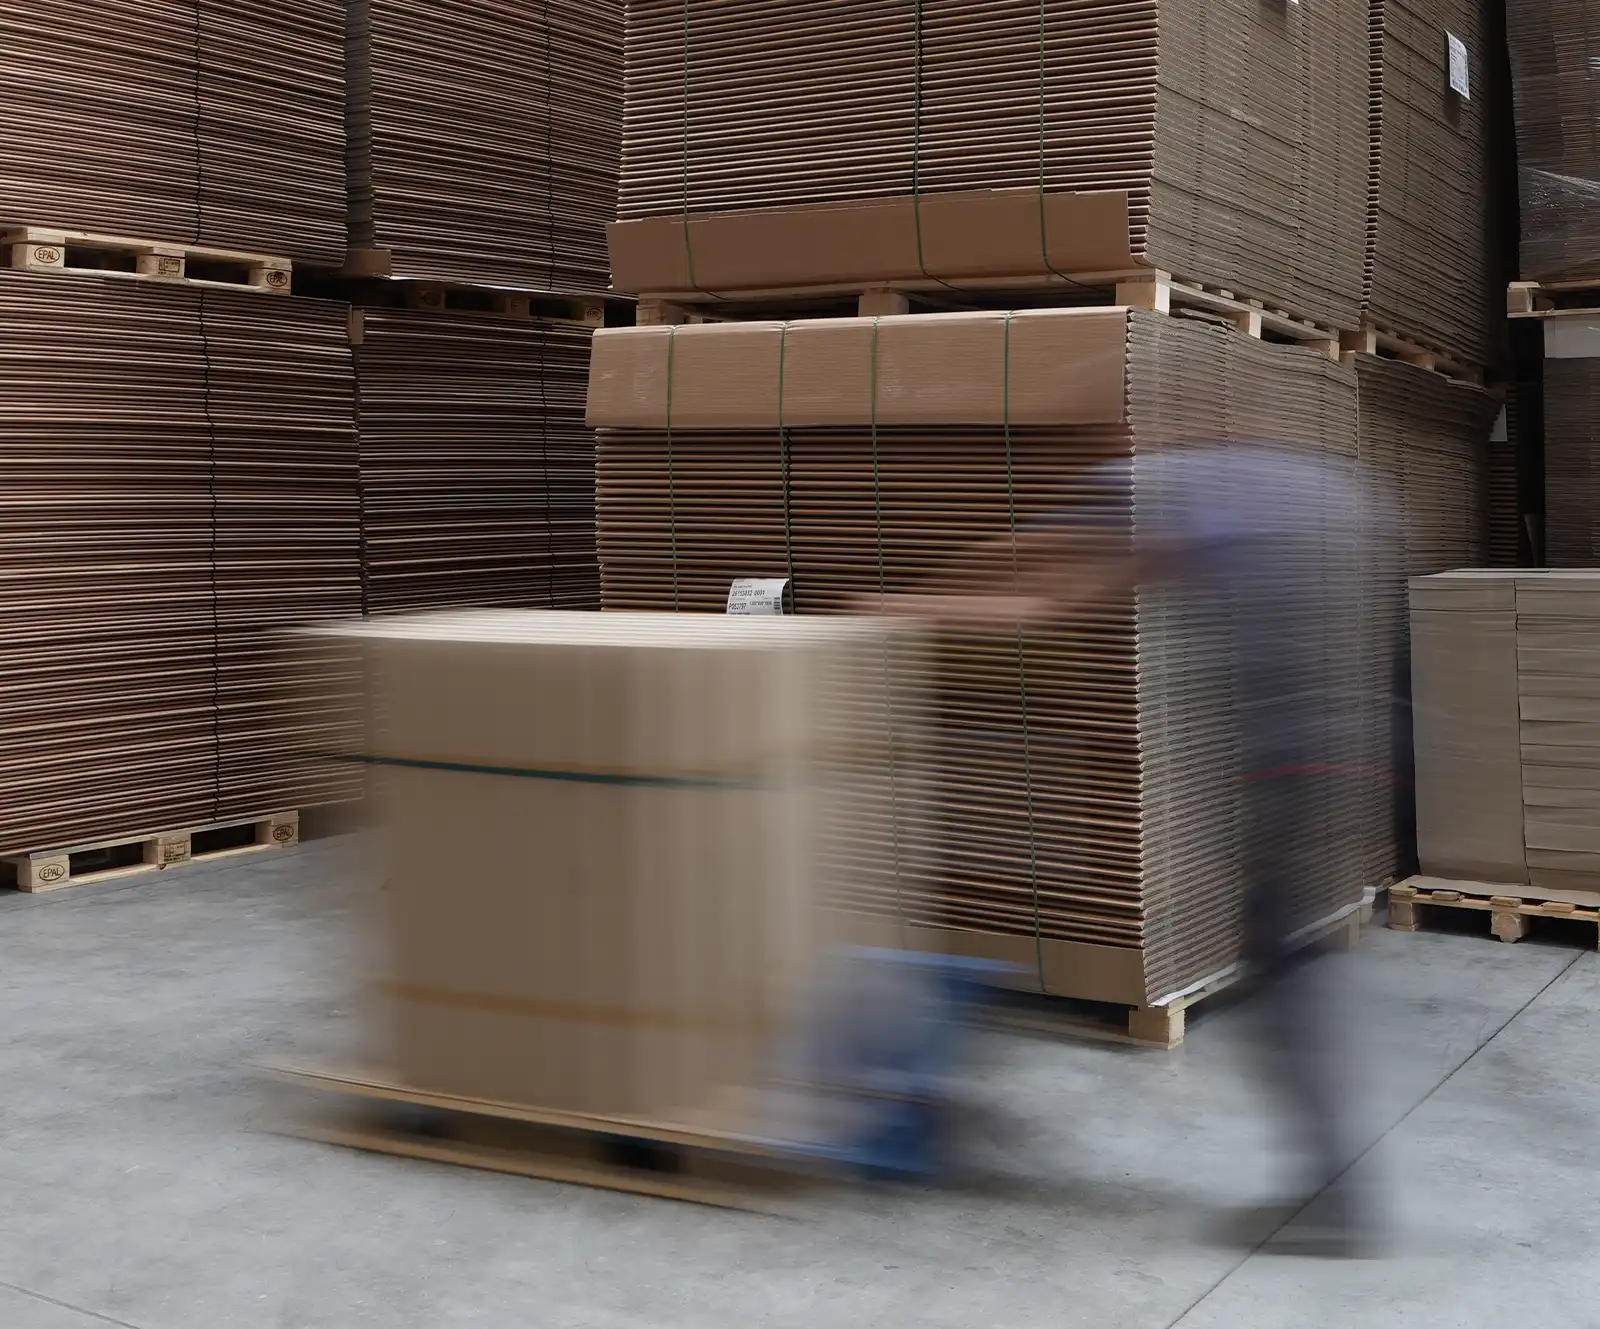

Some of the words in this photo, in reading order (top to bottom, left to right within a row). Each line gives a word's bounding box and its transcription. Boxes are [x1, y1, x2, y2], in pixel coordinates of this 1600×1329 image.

[38, 249, 56, 260] EPAL
[270, 274, 284, 284] EPAL
[276, 828, 291, 838] EPAL
[43, 867, 60, 878] EPAL
